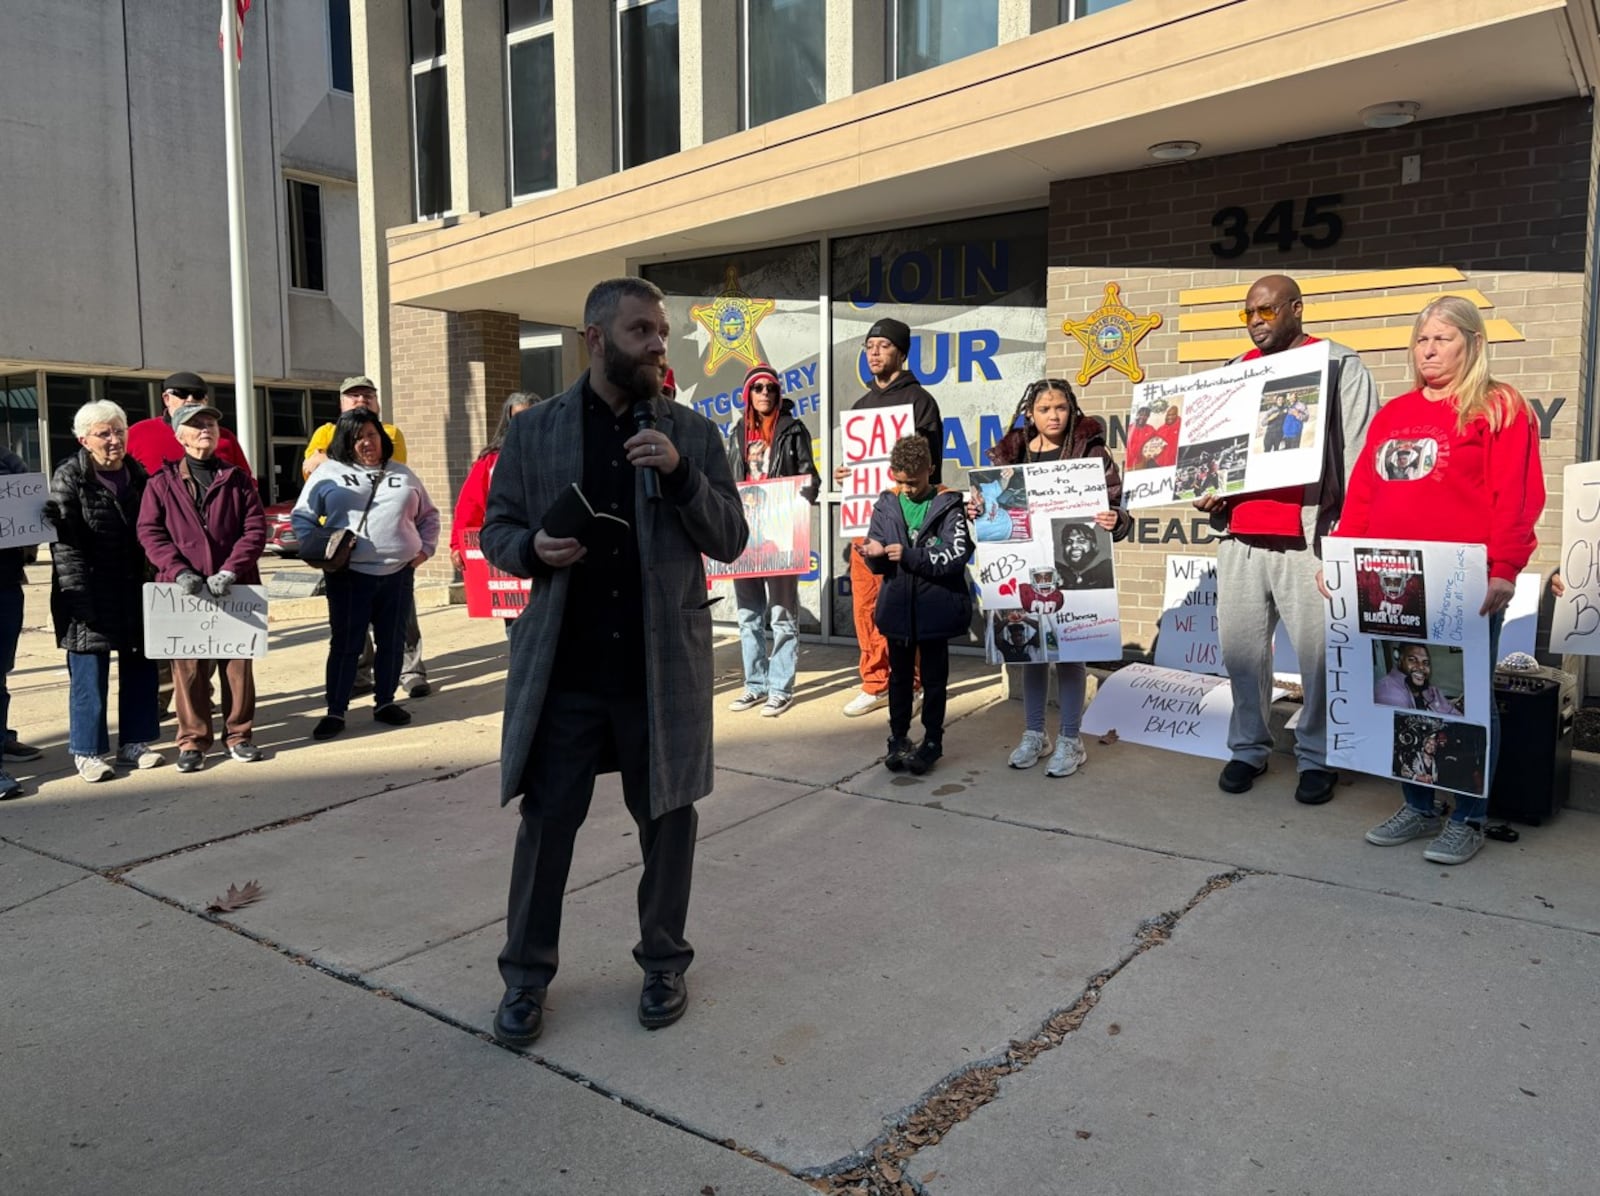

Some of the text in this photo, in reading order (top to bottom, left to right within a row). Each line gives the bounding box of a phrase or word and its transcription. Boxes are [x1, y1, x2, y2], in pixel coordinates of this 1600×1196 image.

[1211, 193, 1344, 258] 345
[848, 240, 1009, 311] JOIN
[846, 413, 908, 461] SAY
[1125, 479, 1174, 502] #BLM
[842, 500, 875, 526] NA
[0, 515, 52, 538] Black
[980, 553, 1026, 585] #CB3
[1172, 560, 1201, 580] WE
[1356, 553, 1422, 575] FOOTBALL
[151, 586, 261, 618] Miscarriage
[491, 592, 500, 606] A
[200, 615, 218, 630] of
[1175, 615, 1198, 633] WE
[164, 633, 257, 656] Justice!
[1185, 642, 1218, 665] JUS
[1326, 560, 1354, 751] JUSTICE
[1130, 676, 1210, 697] CHRISTIAN
[1141, 694, 1207, 716] MARTIN
[1144, 716, 1201, 738] BLACK
